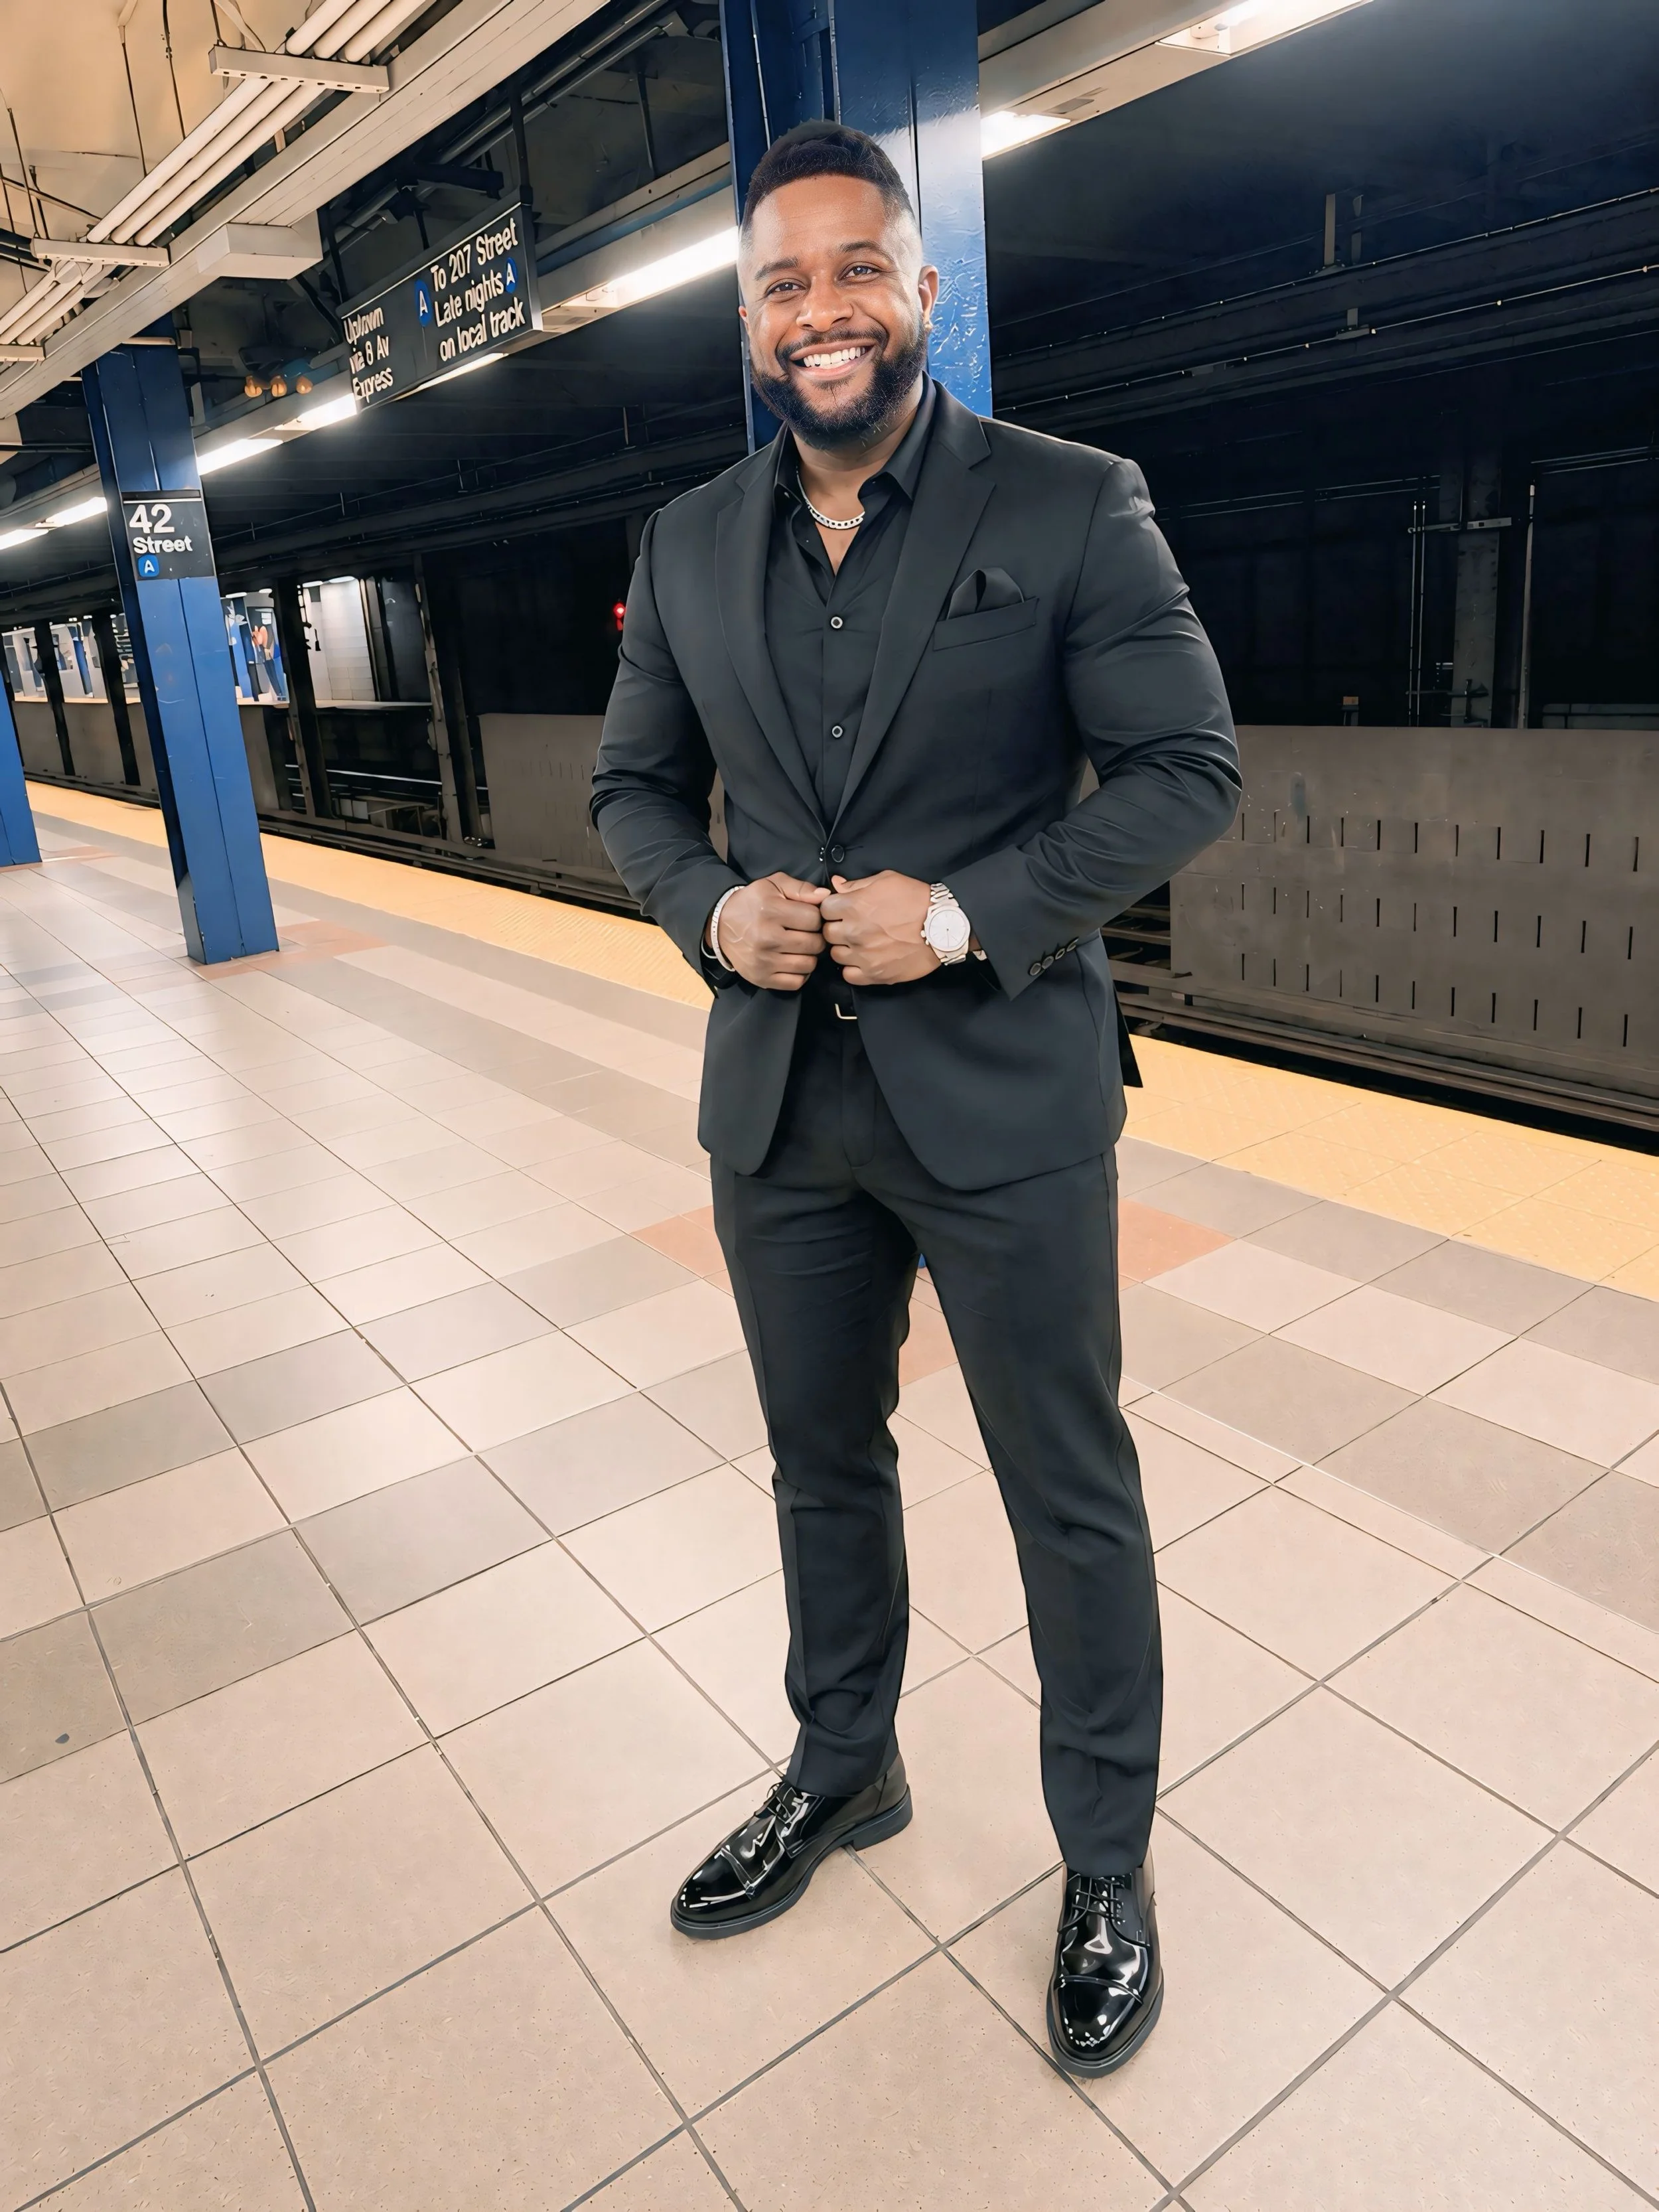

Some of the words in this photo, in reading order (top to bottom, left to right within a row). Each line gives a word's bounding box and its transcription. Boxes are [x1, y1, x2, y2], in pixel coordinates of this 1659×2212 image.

[430, 265, 447, 292] To
[449, 244, 471, 283] 207
[476, 218, 518, 265] Street
[419, 290, 429, 317] A
[434, 295, 463, 327] Late
[465, 269, 504, 313] nights
[506, 263, 516, 286] A
[439, 337, 456, 362] on
[457, 314, 488, 353] local
[490, 297, 526, 338] track
[365, 340, 374, 366] 8
[376, 334, 389, 360] Av
[129, 504, 175, 534] 42
[133, 536, 193, 553] Street
[144, 559, 155, 573] A
